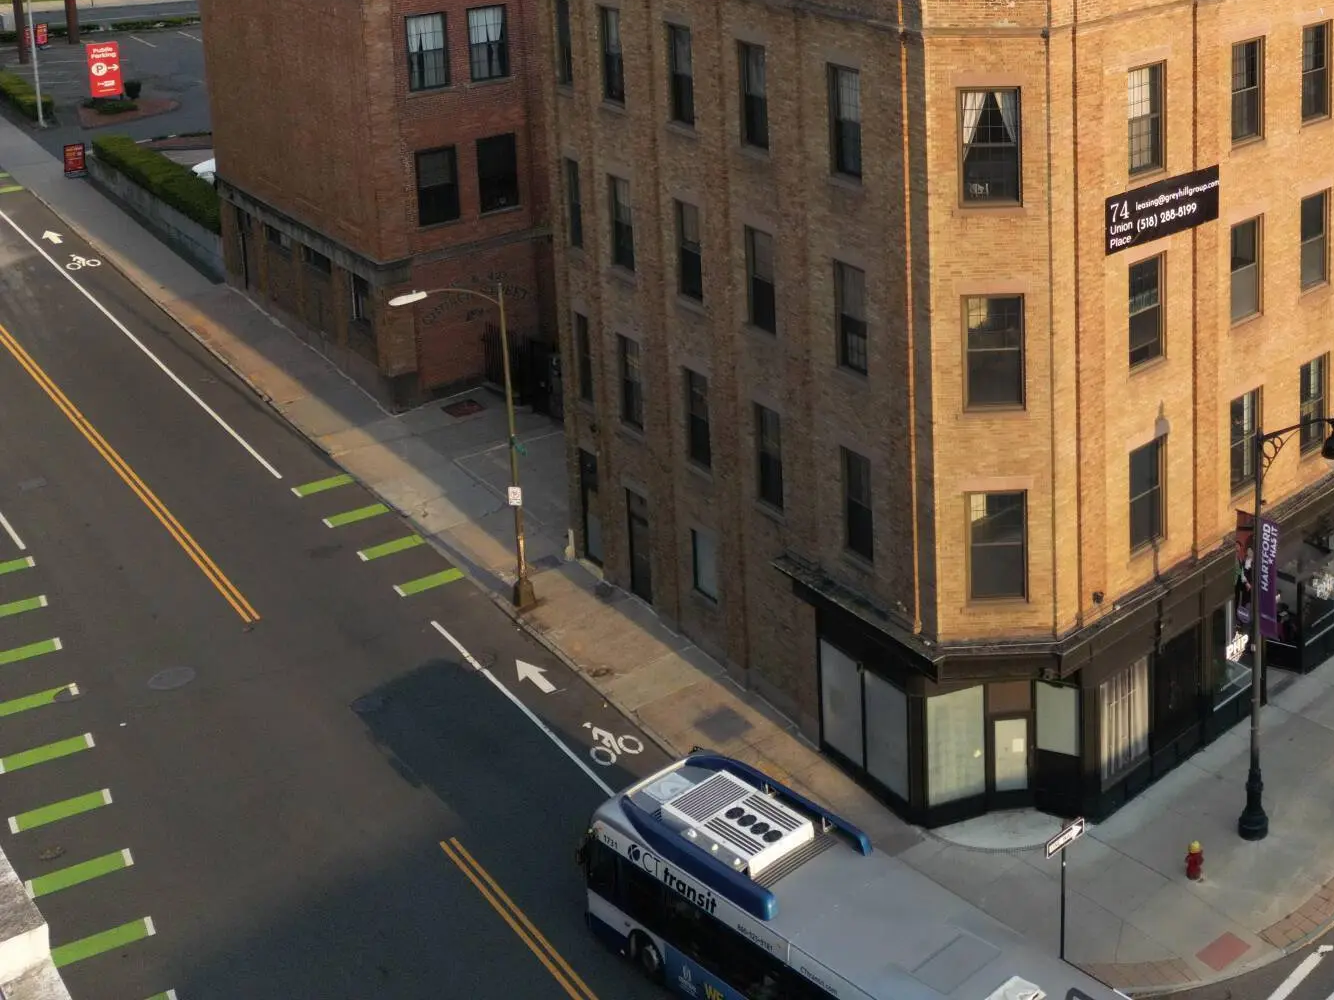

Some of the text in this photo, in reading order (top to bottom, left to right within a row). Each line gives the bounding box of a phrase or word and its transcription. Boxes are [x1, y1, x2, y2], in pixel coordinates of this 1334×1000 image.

[1110, 200, 1130, 222] 74
[1136, 202, 1197, 233] (518) 288-8199
[1110, 221, 1133, 236] Union
[1110, 235, 1132, 249] Place
[1260, 523, 1271, 592] HARTFORD
